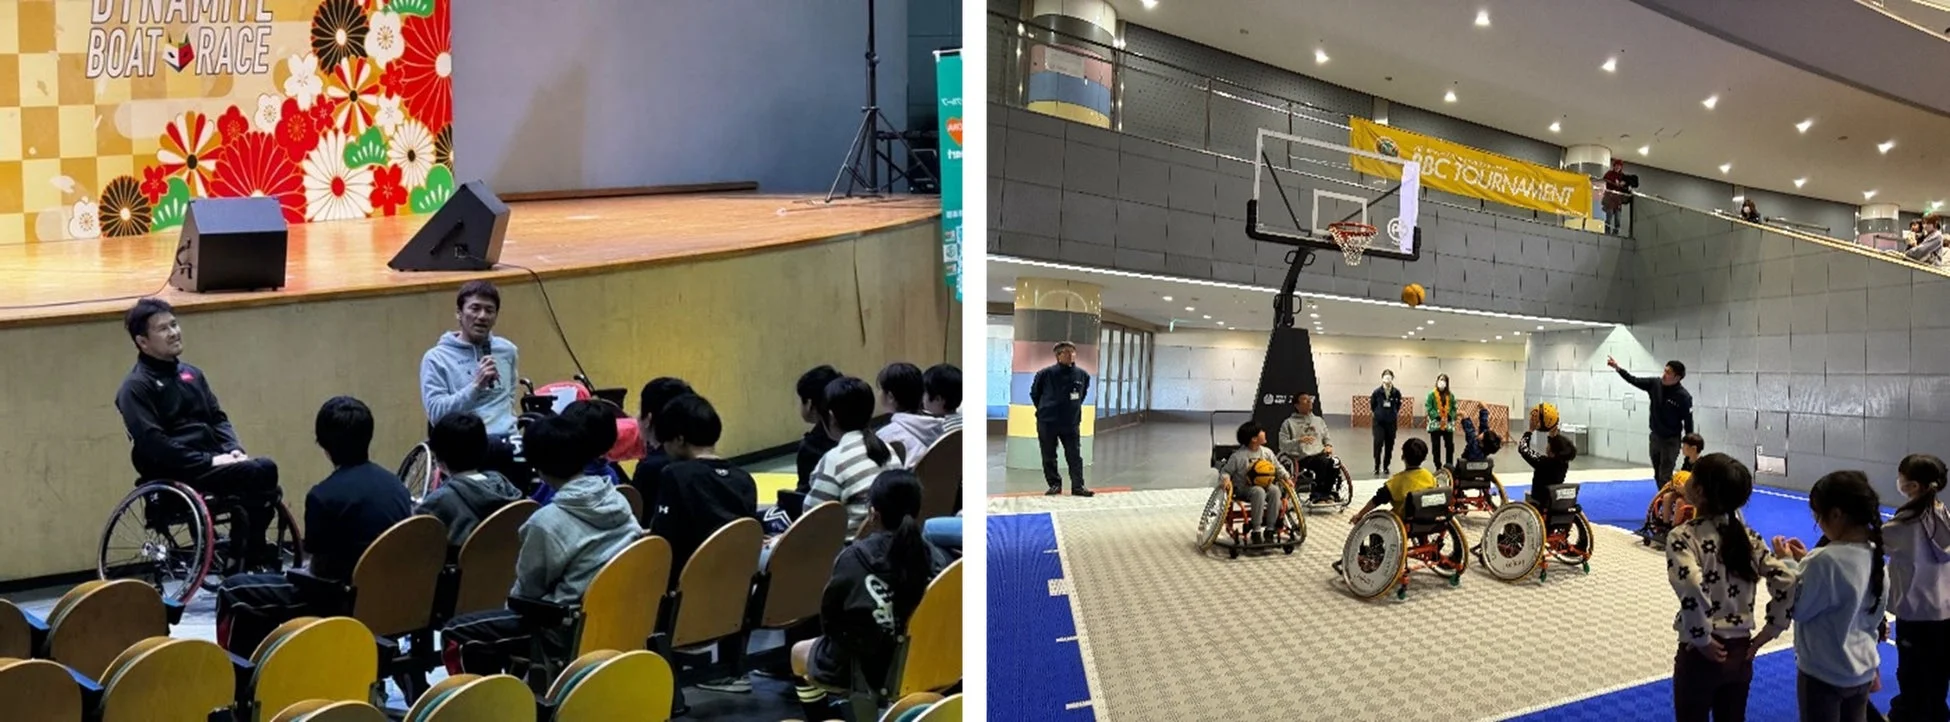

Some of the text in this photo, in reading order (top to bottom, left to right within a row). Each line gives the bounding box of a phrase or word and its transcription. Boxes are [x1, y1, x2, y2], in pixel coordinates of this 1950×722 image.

[86, 26, 272, 78] BOAT RACE
[1454, 161, 1574, 206] TOURNAMENT
